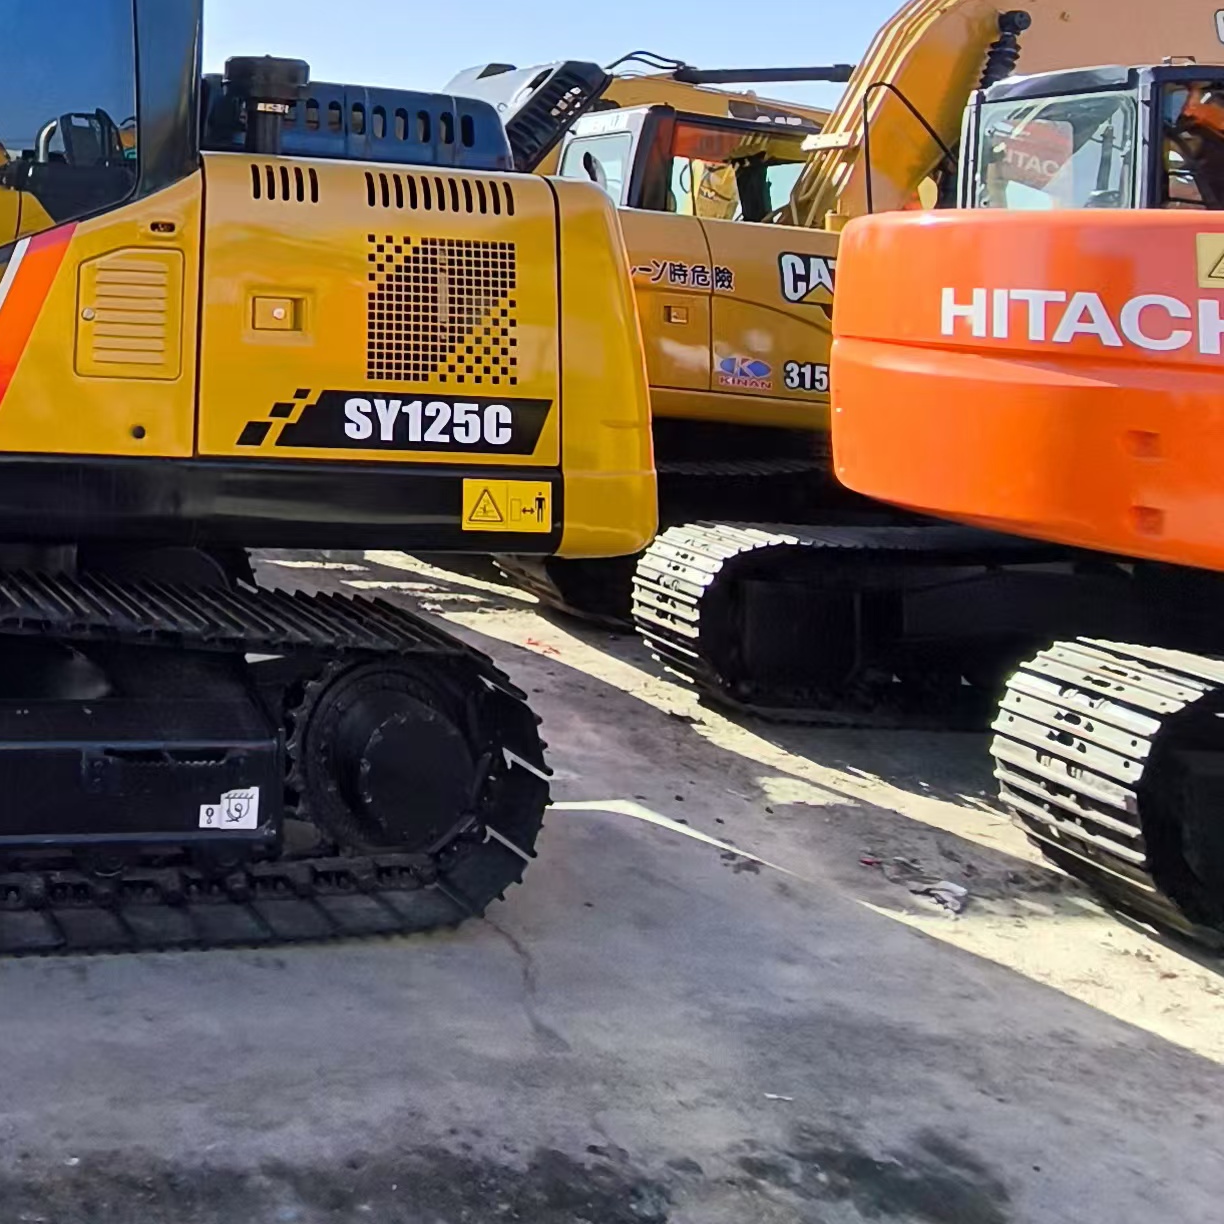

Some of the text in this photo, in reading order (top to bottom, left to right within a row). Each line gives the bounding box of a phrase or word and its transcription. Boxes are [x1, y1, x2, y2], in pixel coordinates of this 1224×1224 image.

[719, 376, 772, 388] KINAN
[785, 362, 829, 391] 315
[344, 397, 513, 445] SY125C
